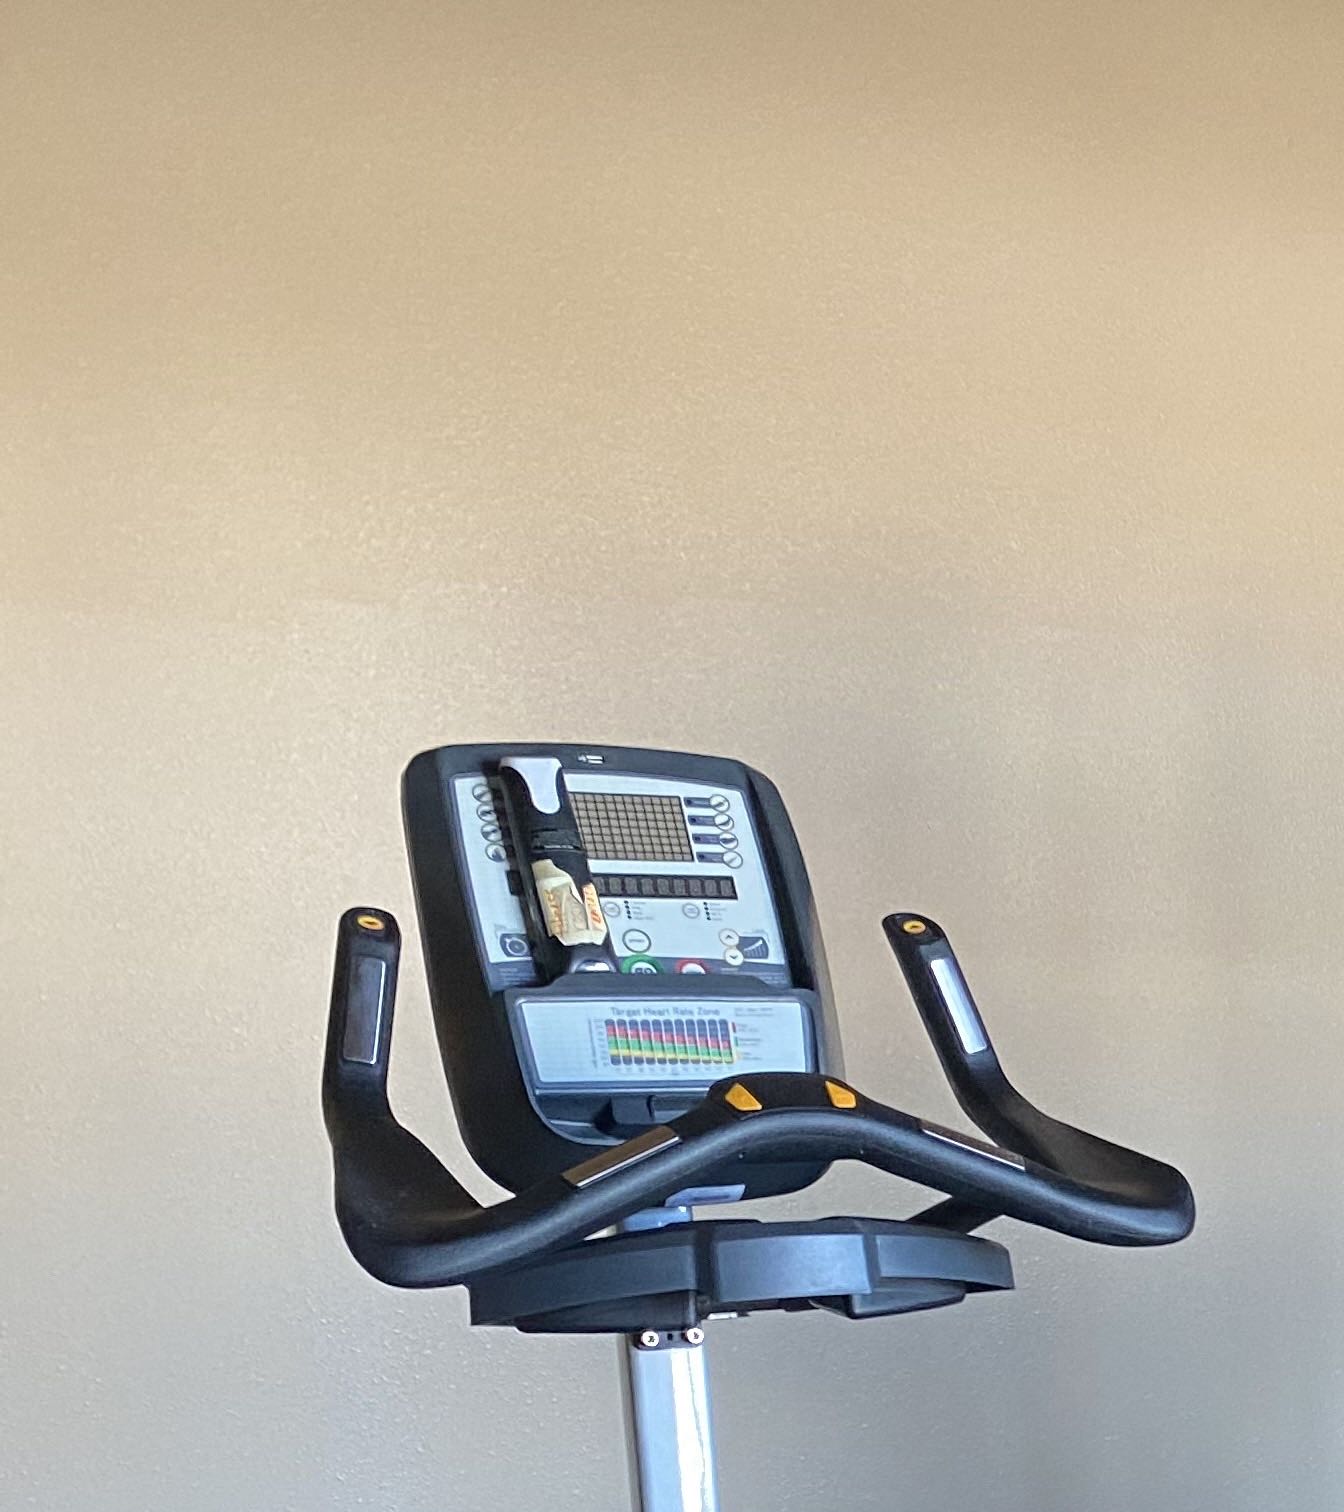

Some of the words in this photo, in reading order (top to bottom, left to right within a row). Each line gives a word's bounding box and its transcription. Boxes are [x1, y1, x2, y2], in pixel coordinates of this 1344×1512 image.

[610, 1006, 641, 1017] Target
[643, 1006, 670, 1016] Heart
[673, 1007, 694, 1017] Rate
[697, 1007, 720, 1016] Zone
